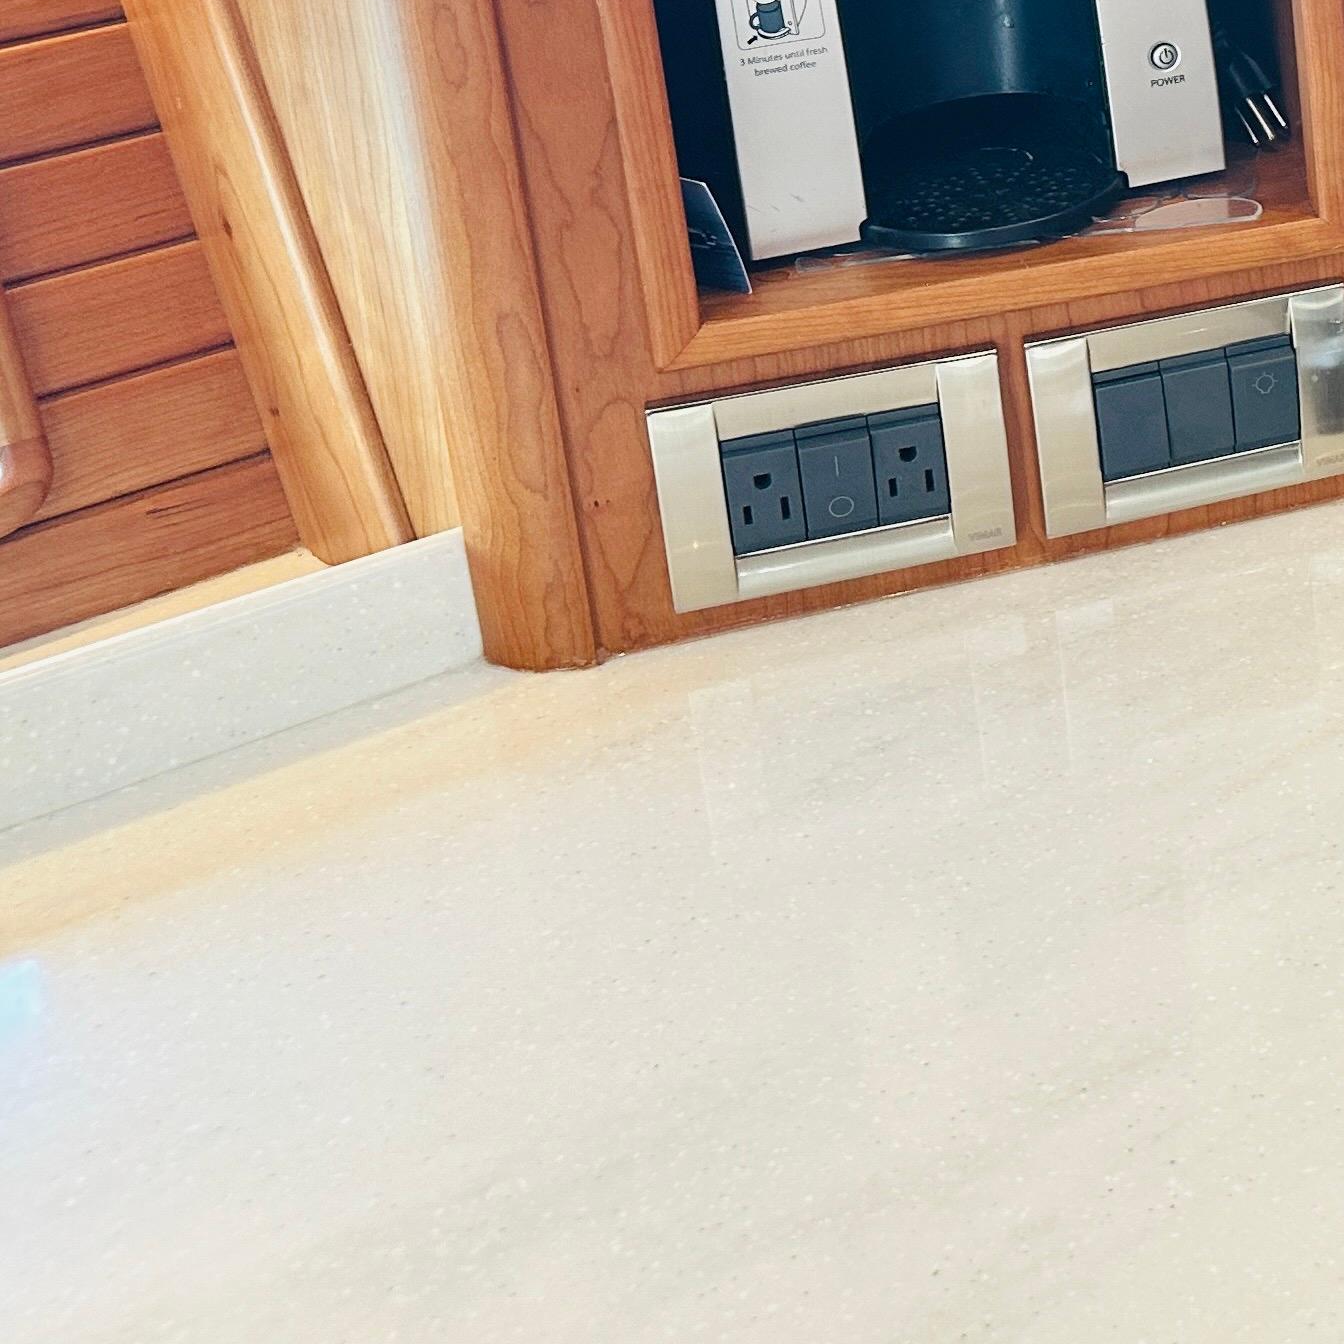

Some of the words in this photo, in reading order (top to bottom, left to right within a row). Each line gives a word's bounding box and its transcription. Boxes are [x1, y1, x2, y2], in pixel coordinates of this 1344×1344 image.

[748, 53, 783, 65] Minutes
[784, 49, 804, 60] until
[805, 46, 828, 57] fresh
[754, 64, 788, 77] brewed
[789, 60, 817, 72] coffee
[1150, 74, 1186, 88] POWER
